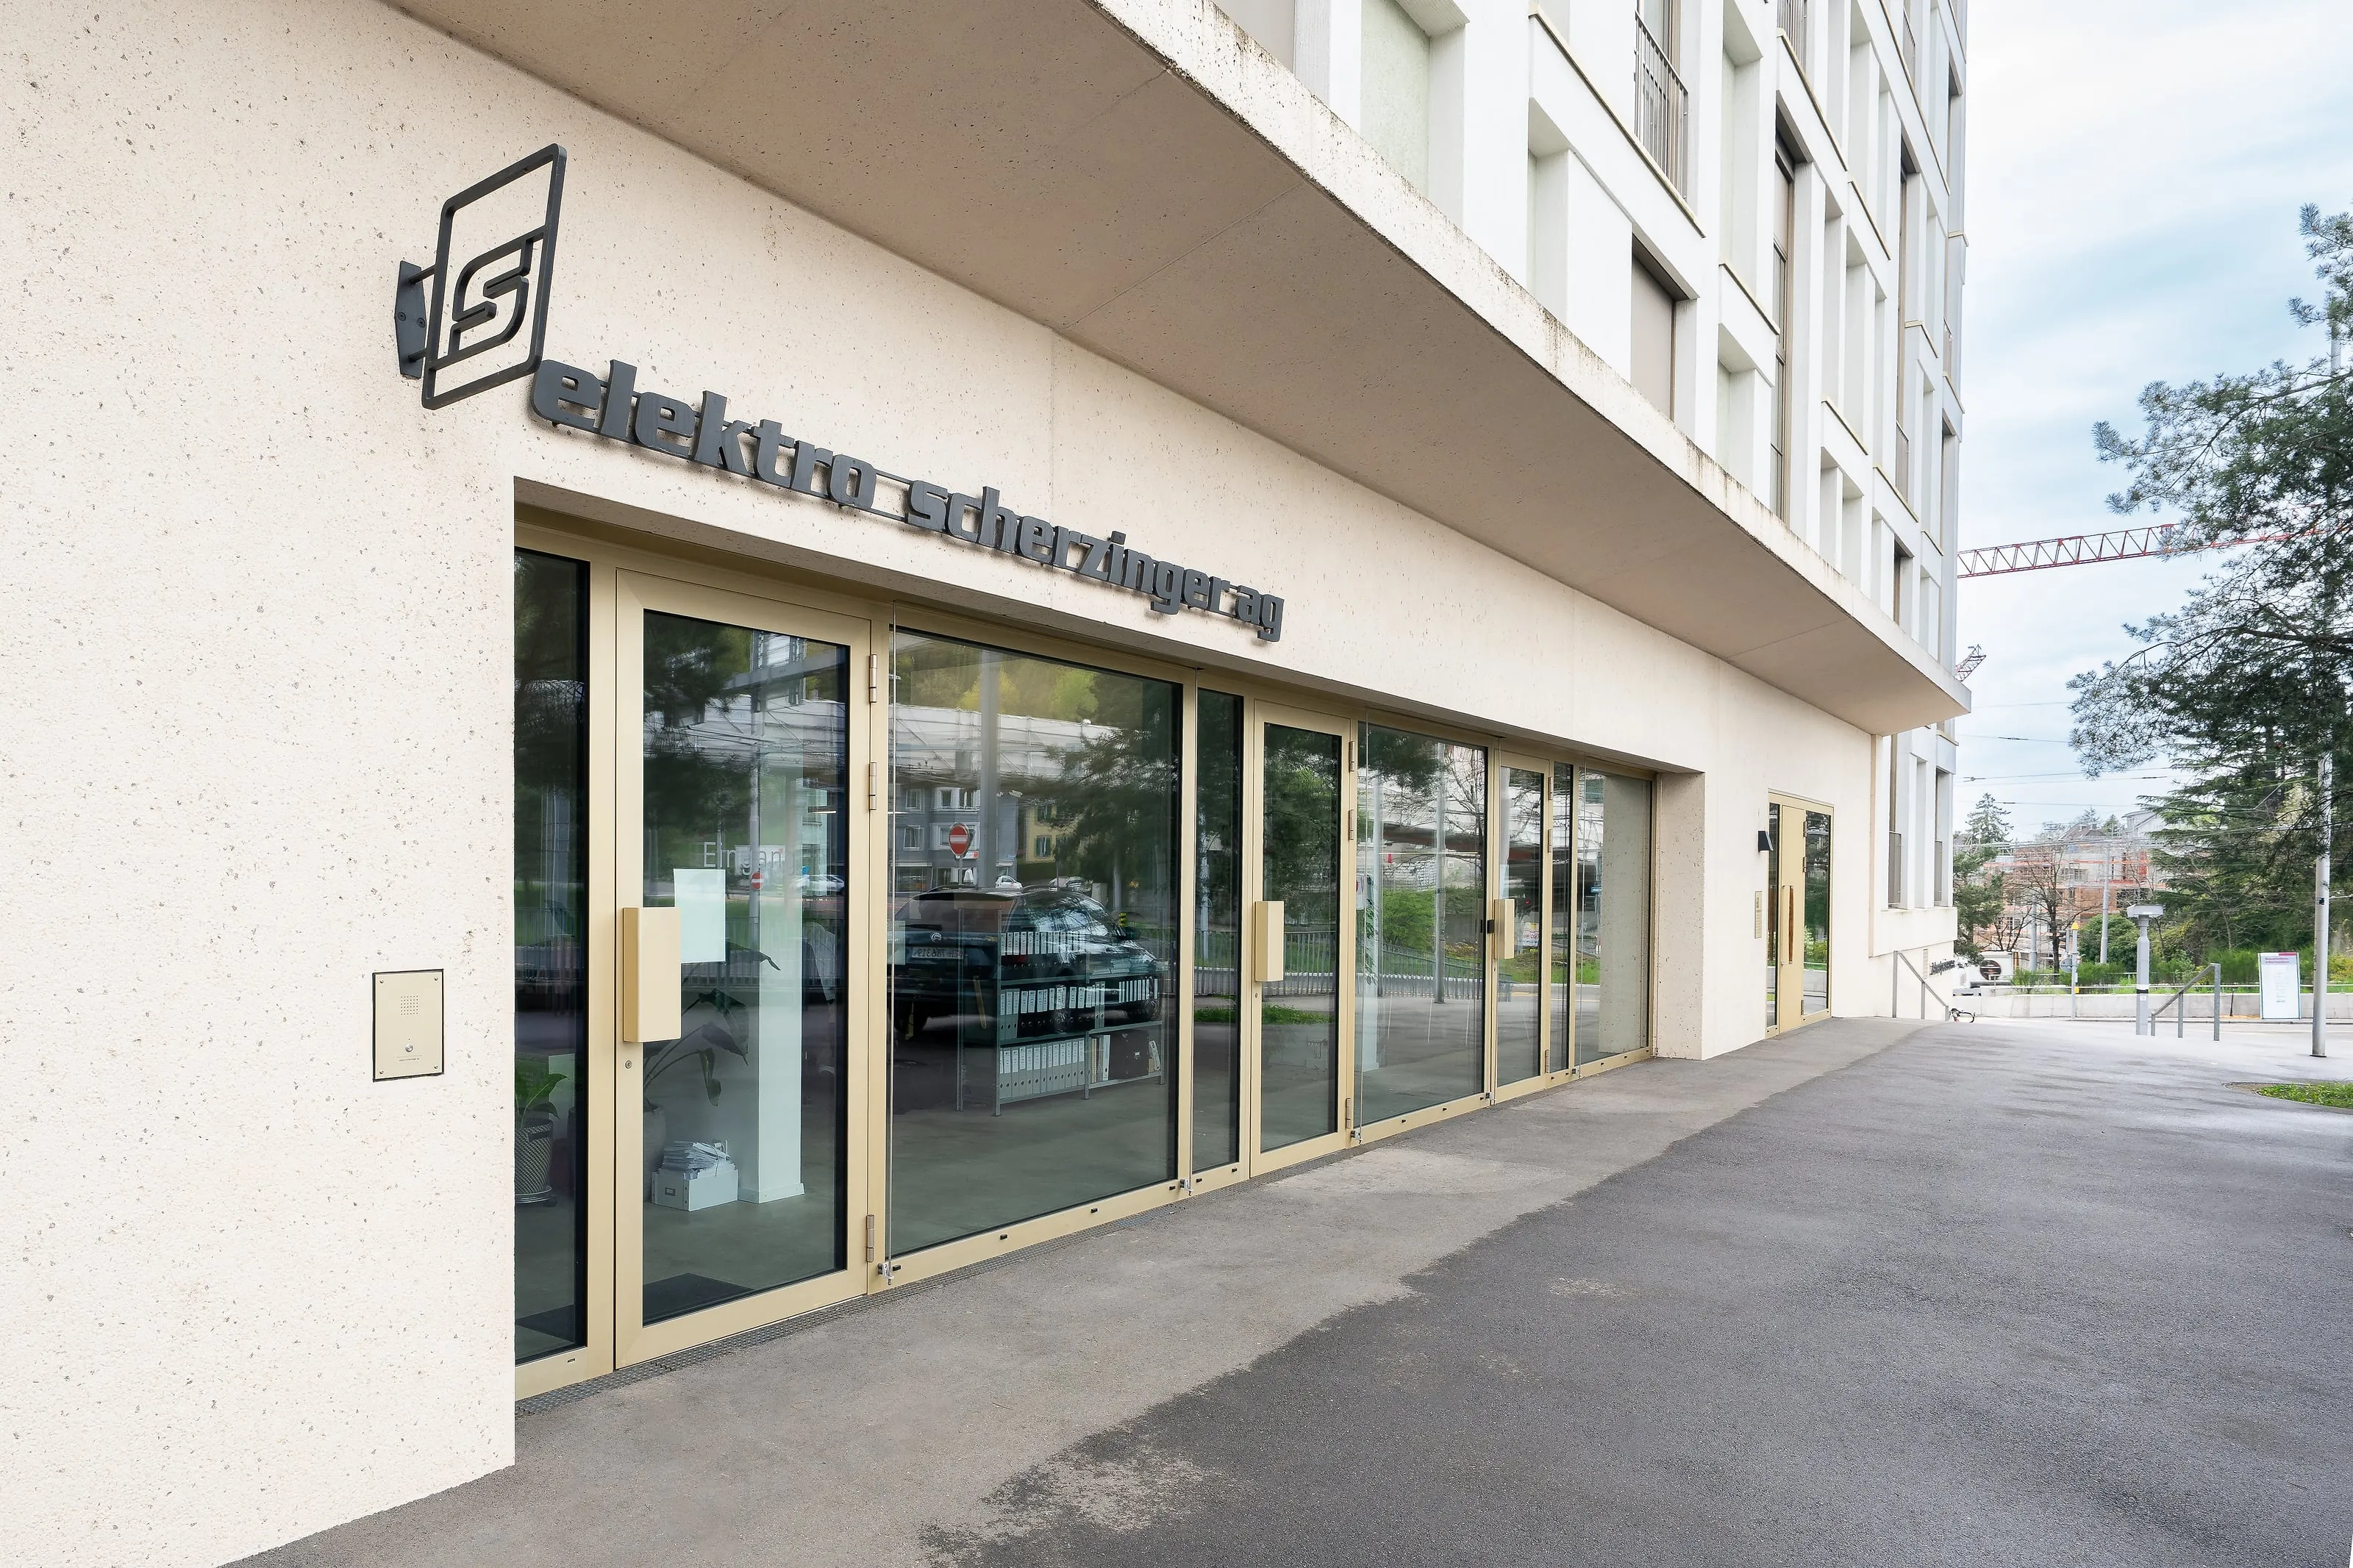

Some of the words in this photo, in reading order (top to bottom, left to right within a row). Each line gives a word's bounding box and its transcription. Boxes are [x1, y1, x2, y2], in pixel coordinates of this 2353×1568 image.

[532, 359, 877, 509] elektro
[908, 486, 1230, 615] scherzinger
[1235, 585, 1285, 642] ag
